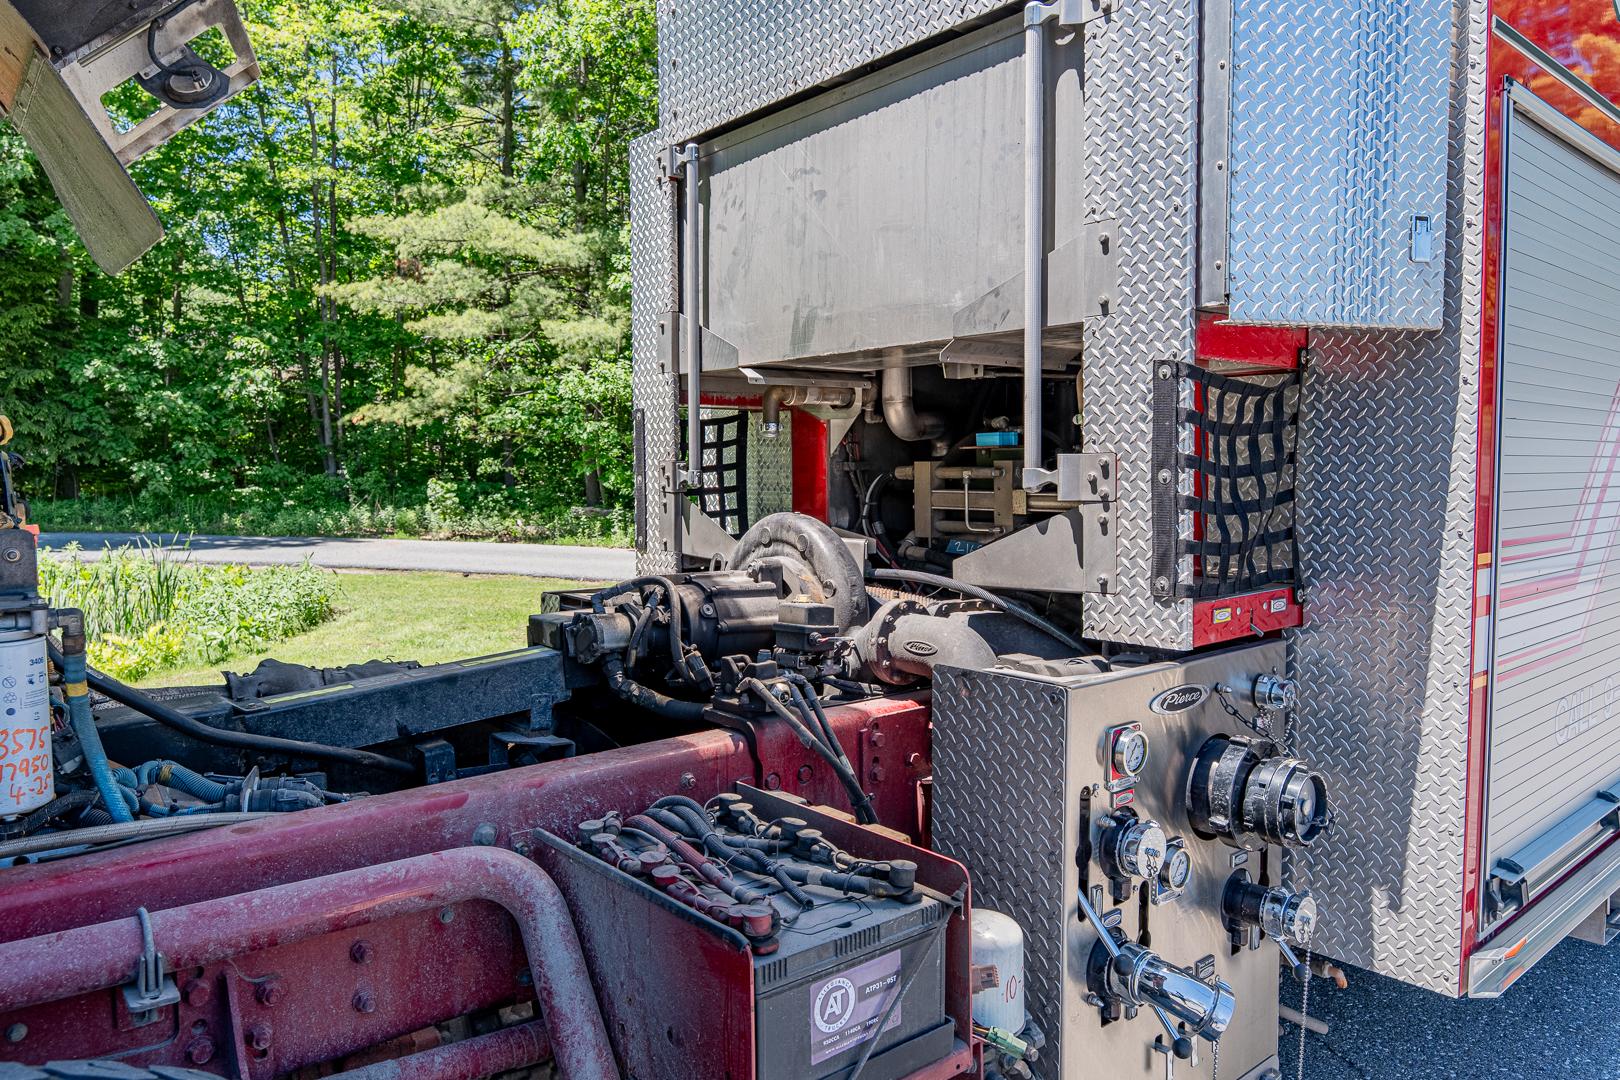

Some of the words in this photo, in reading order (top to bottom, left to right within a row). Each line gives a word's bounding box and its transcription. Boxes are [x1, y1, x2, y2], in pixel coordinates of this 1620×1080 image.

[1162, 691, 1200, 710] Pierce
[1555, 685, 1598, 746] CALL
[865, 974, 897, 995] ATP31-95T
[823, 988, 846, 1021] AT
